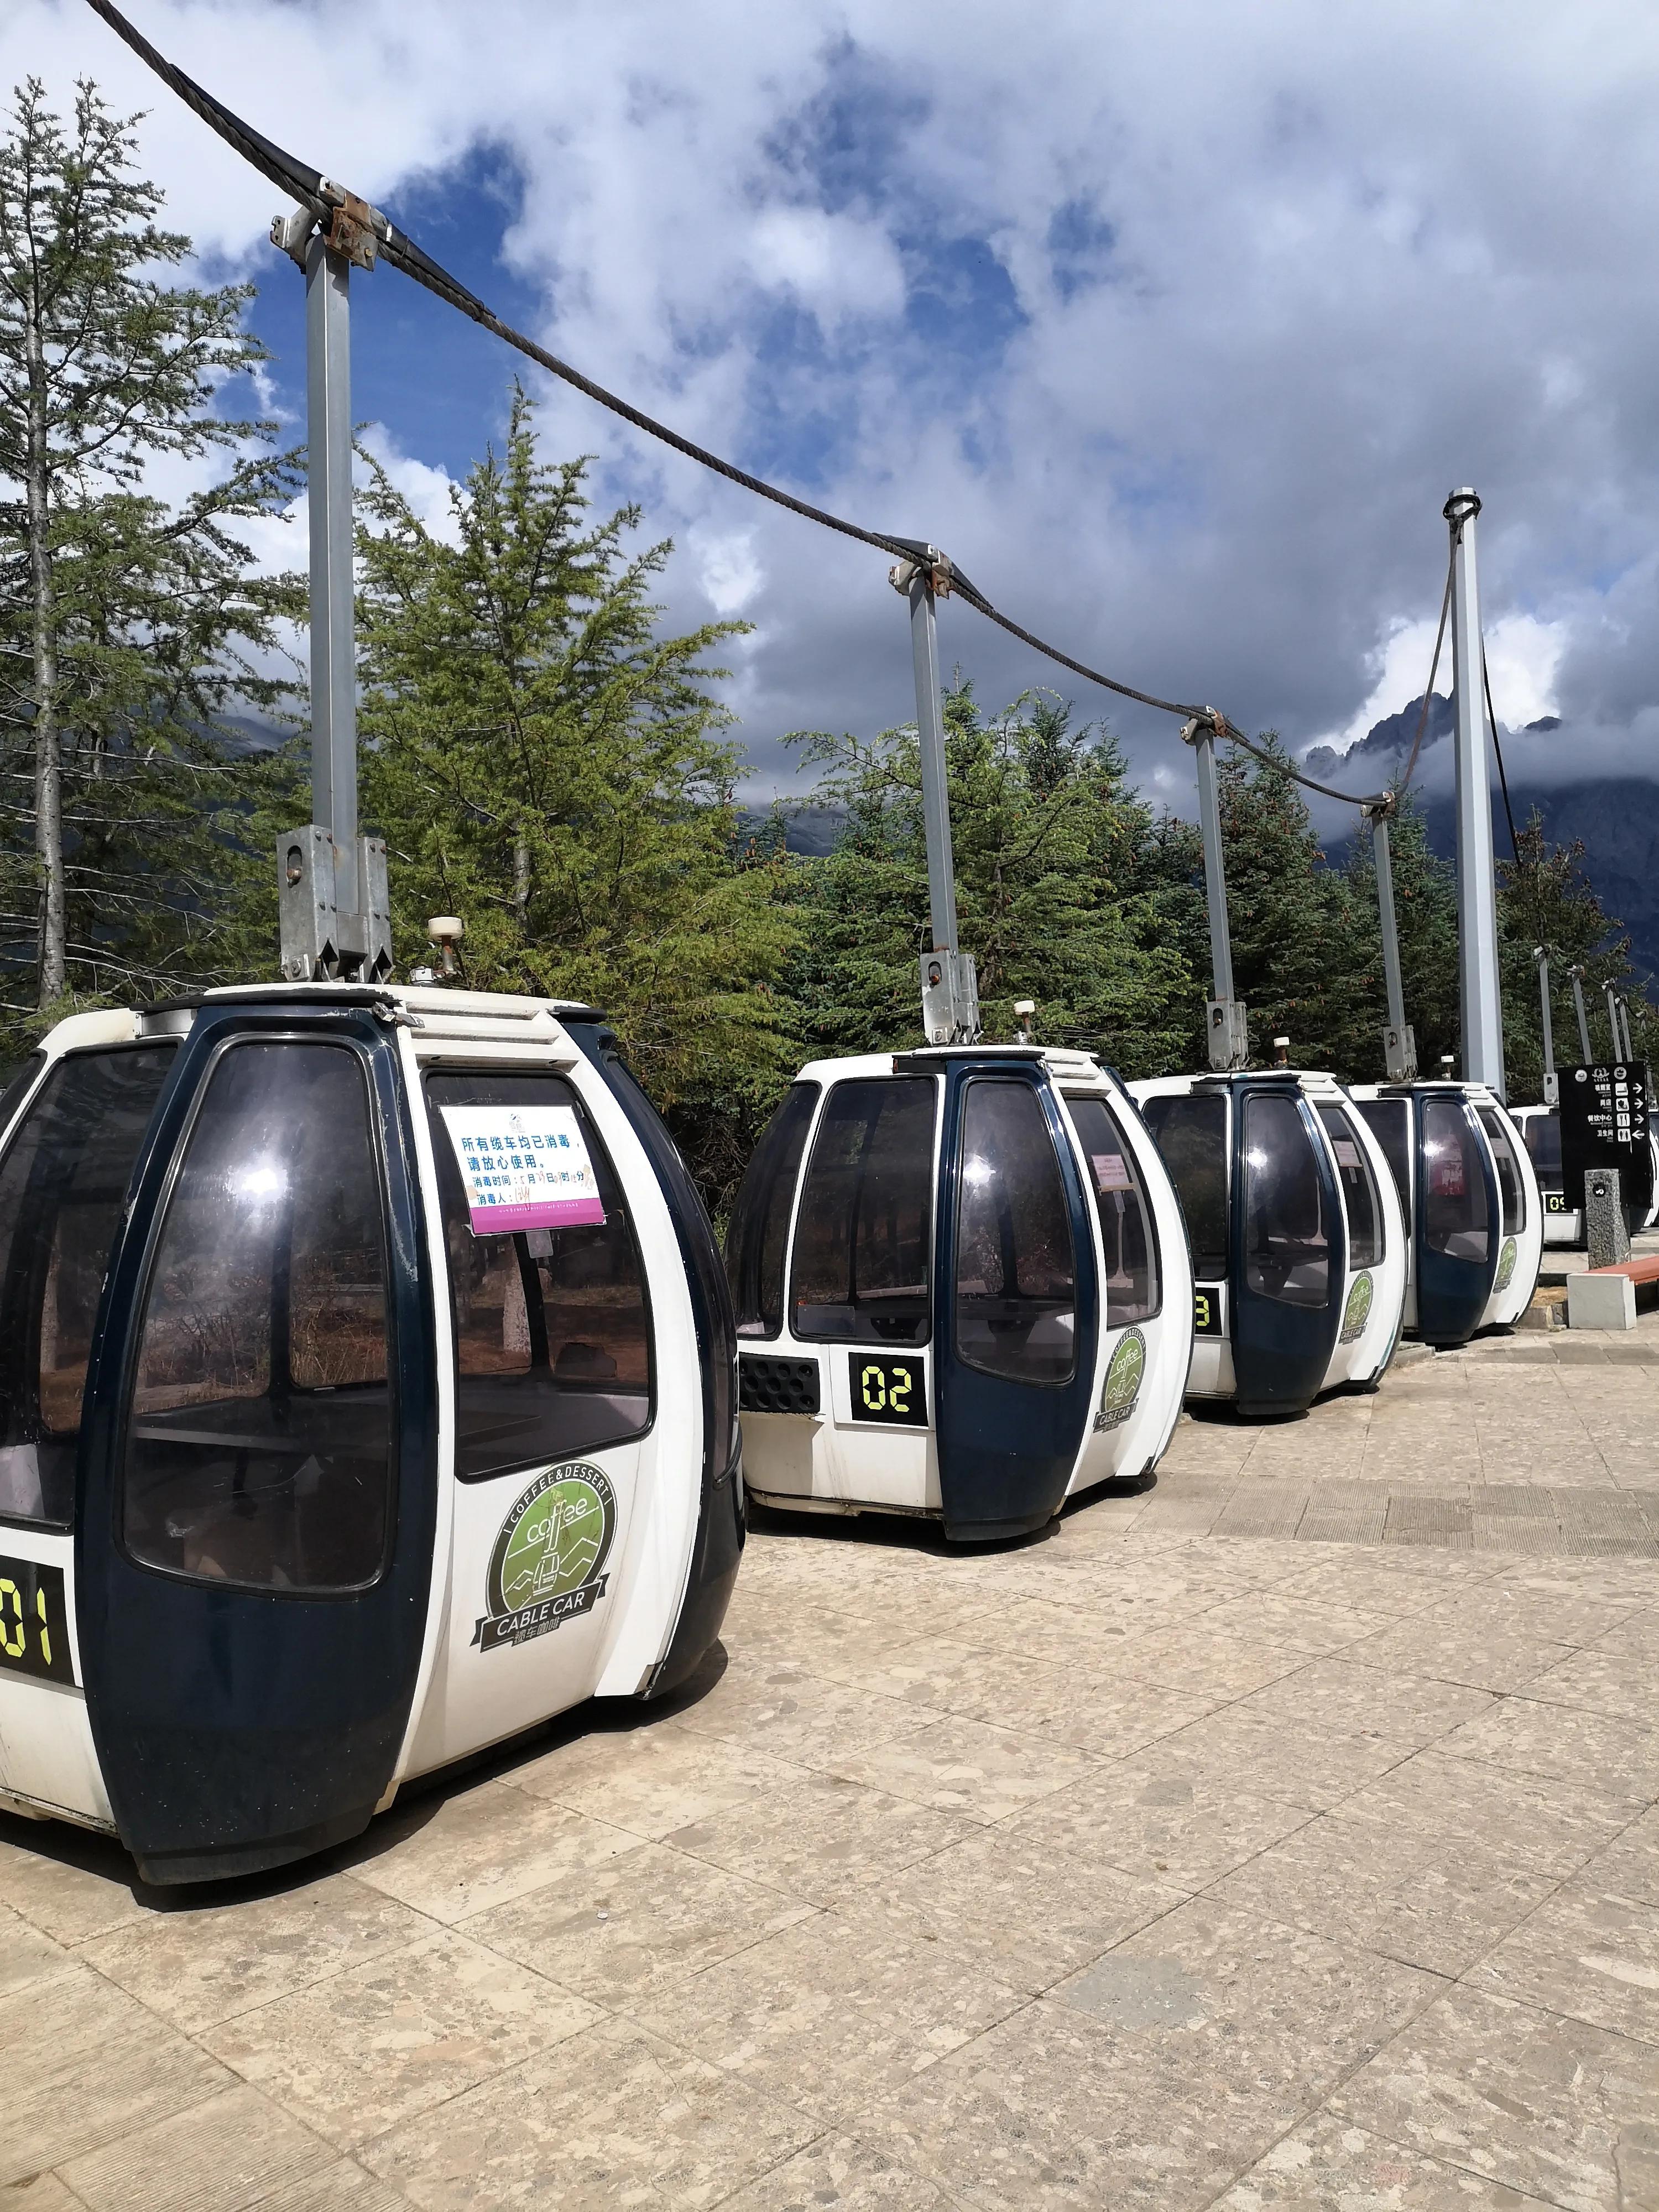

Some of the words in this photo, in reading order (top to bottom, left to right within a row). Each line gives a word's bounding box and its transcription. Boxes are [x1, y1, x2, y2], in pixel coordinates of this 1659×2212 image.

[467, 1154, 544, 1171] 请放心使用。
[1117, 1348, 1138, 1379] coffee
[862, 1366, 912, 1412] 02
[1099, 1411, 1118, 1426] CABLE
[1118, 1406, 1130, 1418] CAR
[510, 1465, 609, 1524] COFFEE&DESSERT
[527, 1498, 588, 1552] coffee
[0, 1578, 52, 1666] 01
[498, 1603, 550, 1636] CABLE
[552, 1592, 585, 1615] CAR
